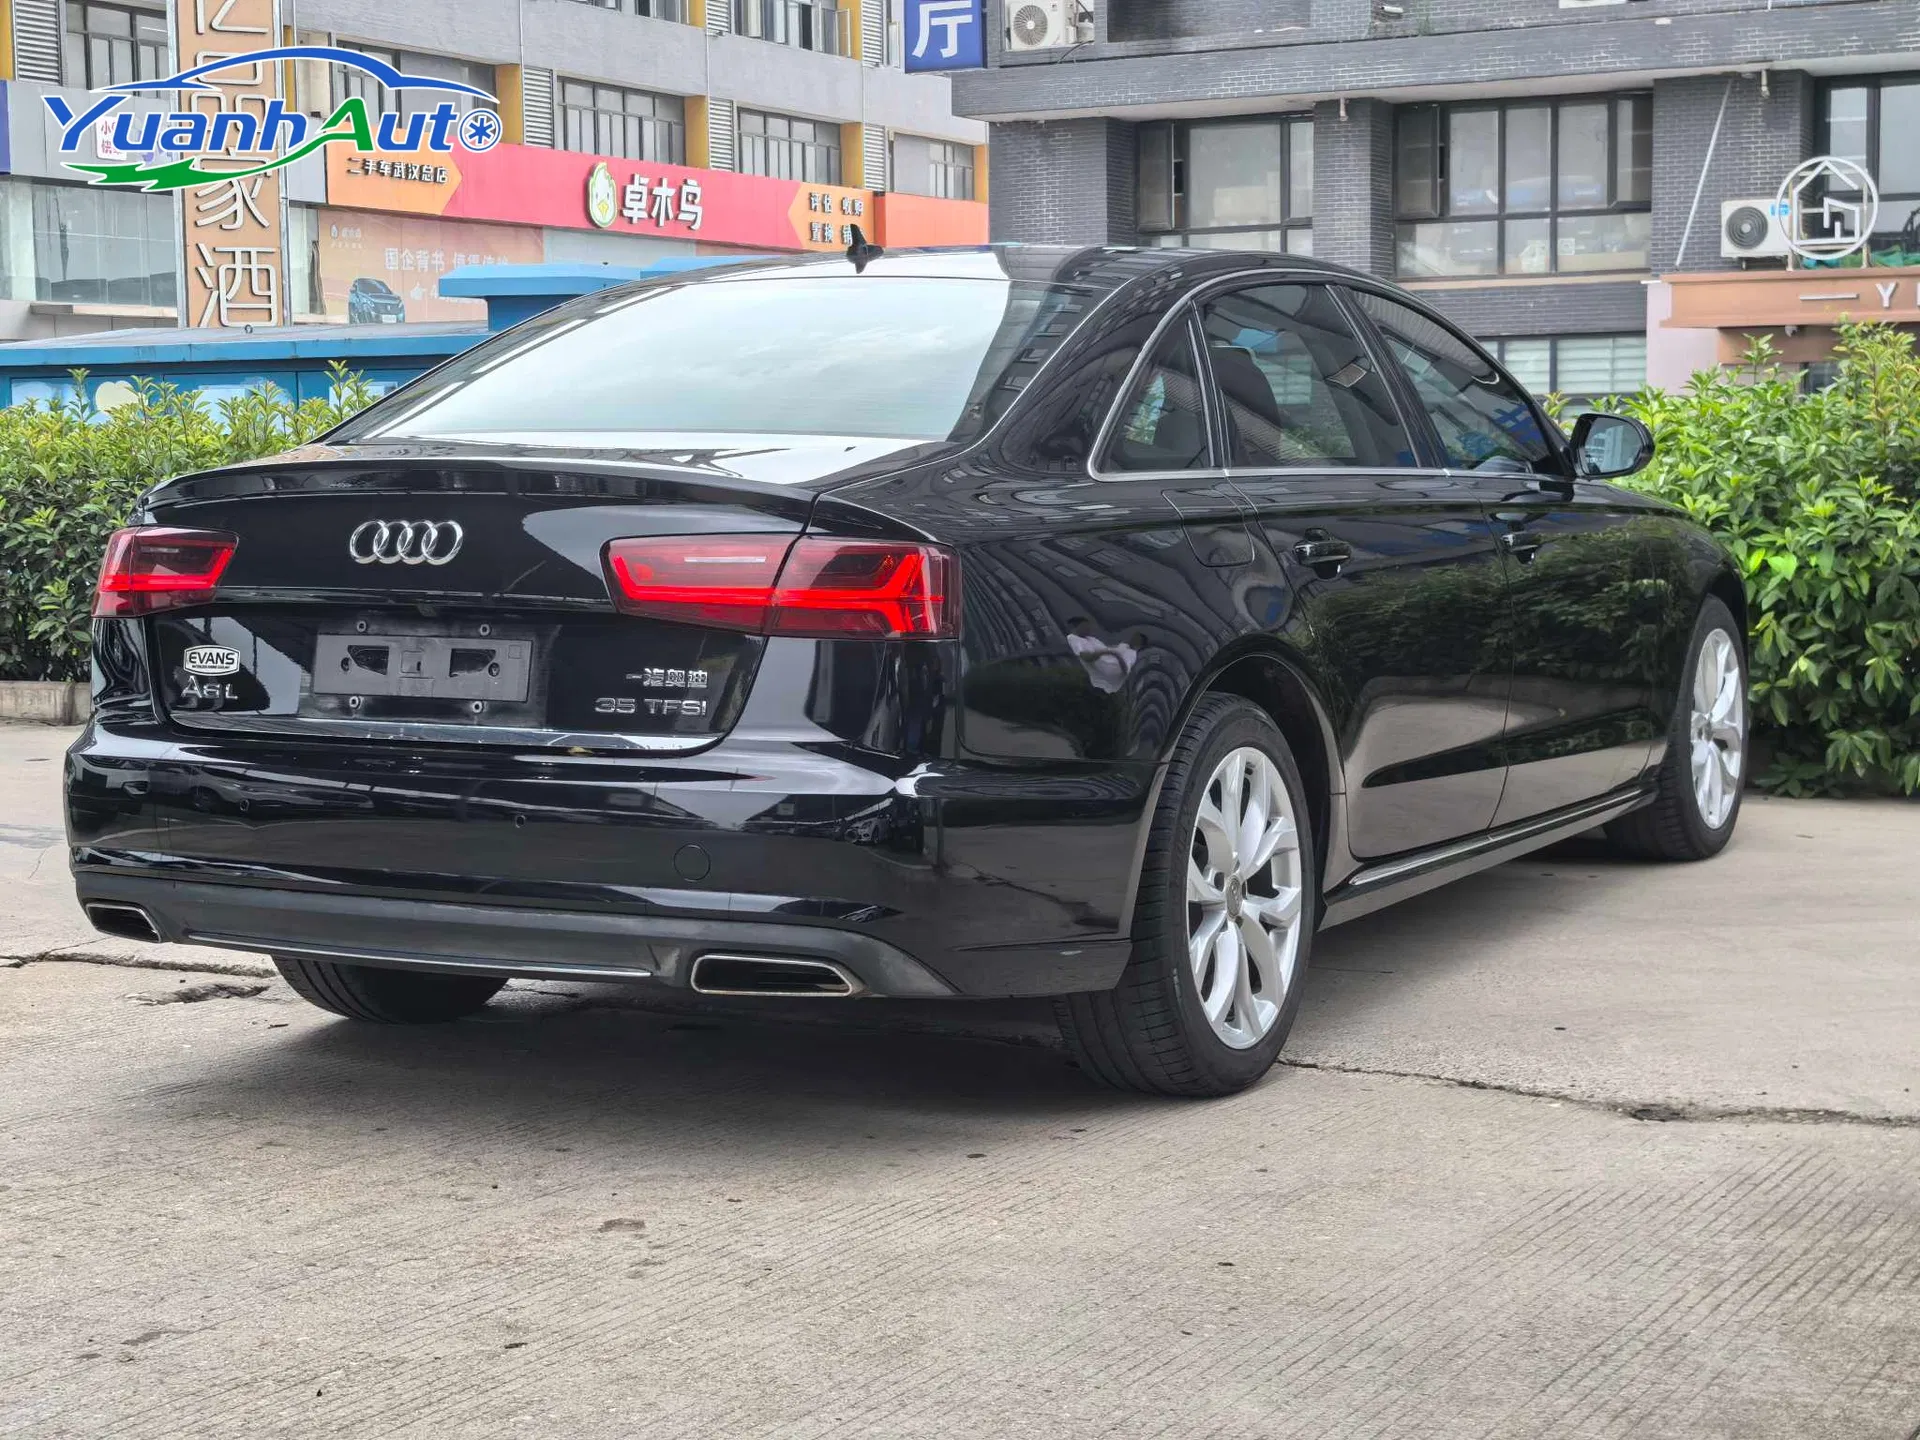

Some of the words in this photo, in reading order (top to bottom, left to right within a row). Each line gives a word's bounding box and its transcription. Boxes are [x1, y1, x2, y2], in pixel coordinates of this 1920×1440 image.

[912, 0, 973, 58] 厅
[346, 157, 448, 185] 二手车武汉总店
[621, 173, 703, 231] 卓木鸟
[384, 247, 446, 273] 国企背书
[188, 651, 236, 665] EVANS
[181, 675, 238, 699] A6L
[594, 697, 636, 714] 35
[643, 698, 707, 716] TFSI
